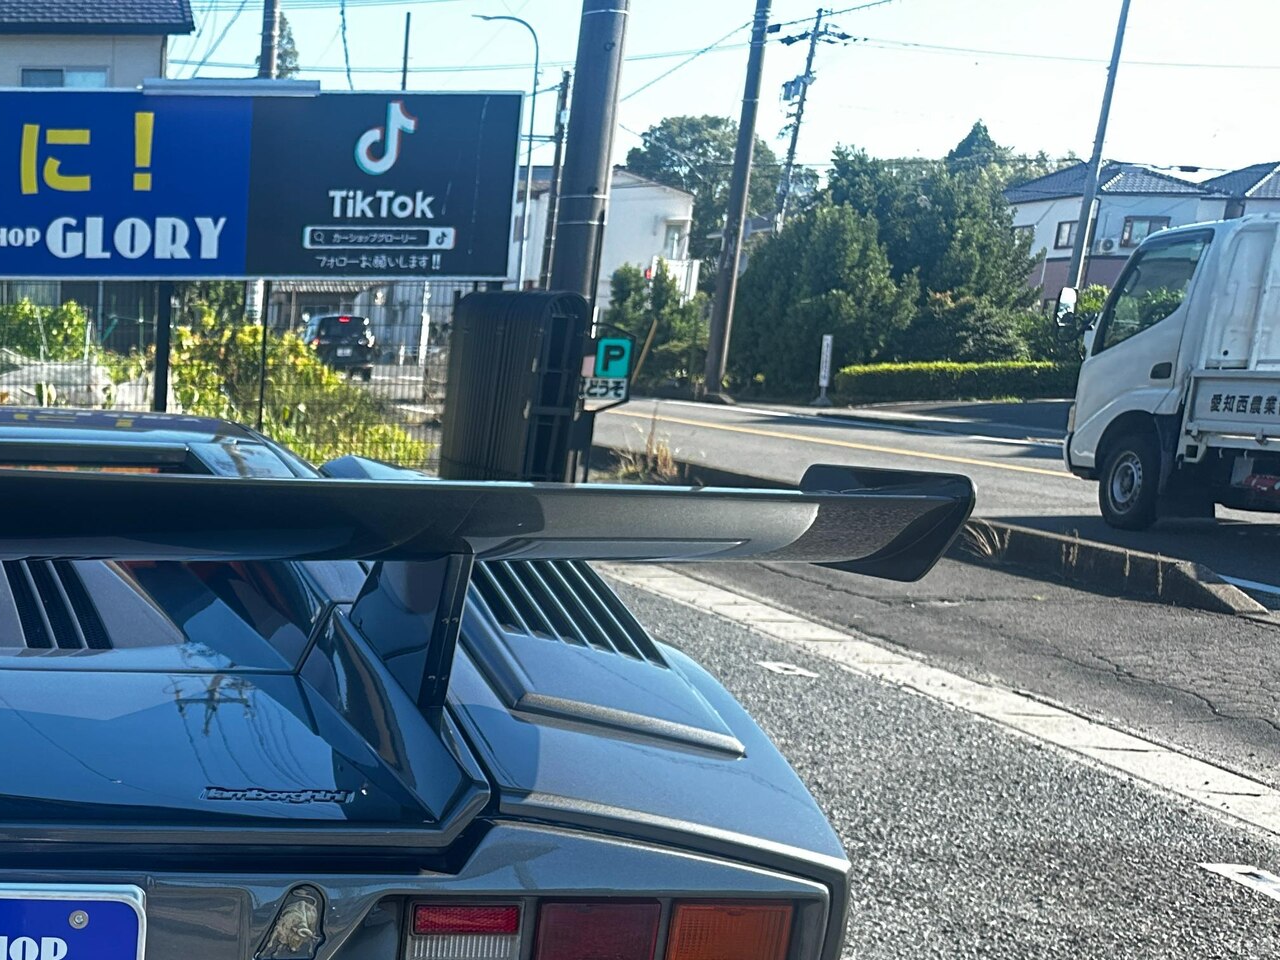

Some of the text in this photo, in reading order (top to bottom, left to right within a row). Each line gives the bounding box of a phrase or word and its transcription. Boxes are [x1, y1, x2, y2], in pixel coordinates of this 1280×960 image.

[328, 190, 435, 218] TikTok
[45, 216, 227, 259] GLORY
[602, 345, 625, 372] P
[1210, 393, 1280, 415] 愛知西農業
